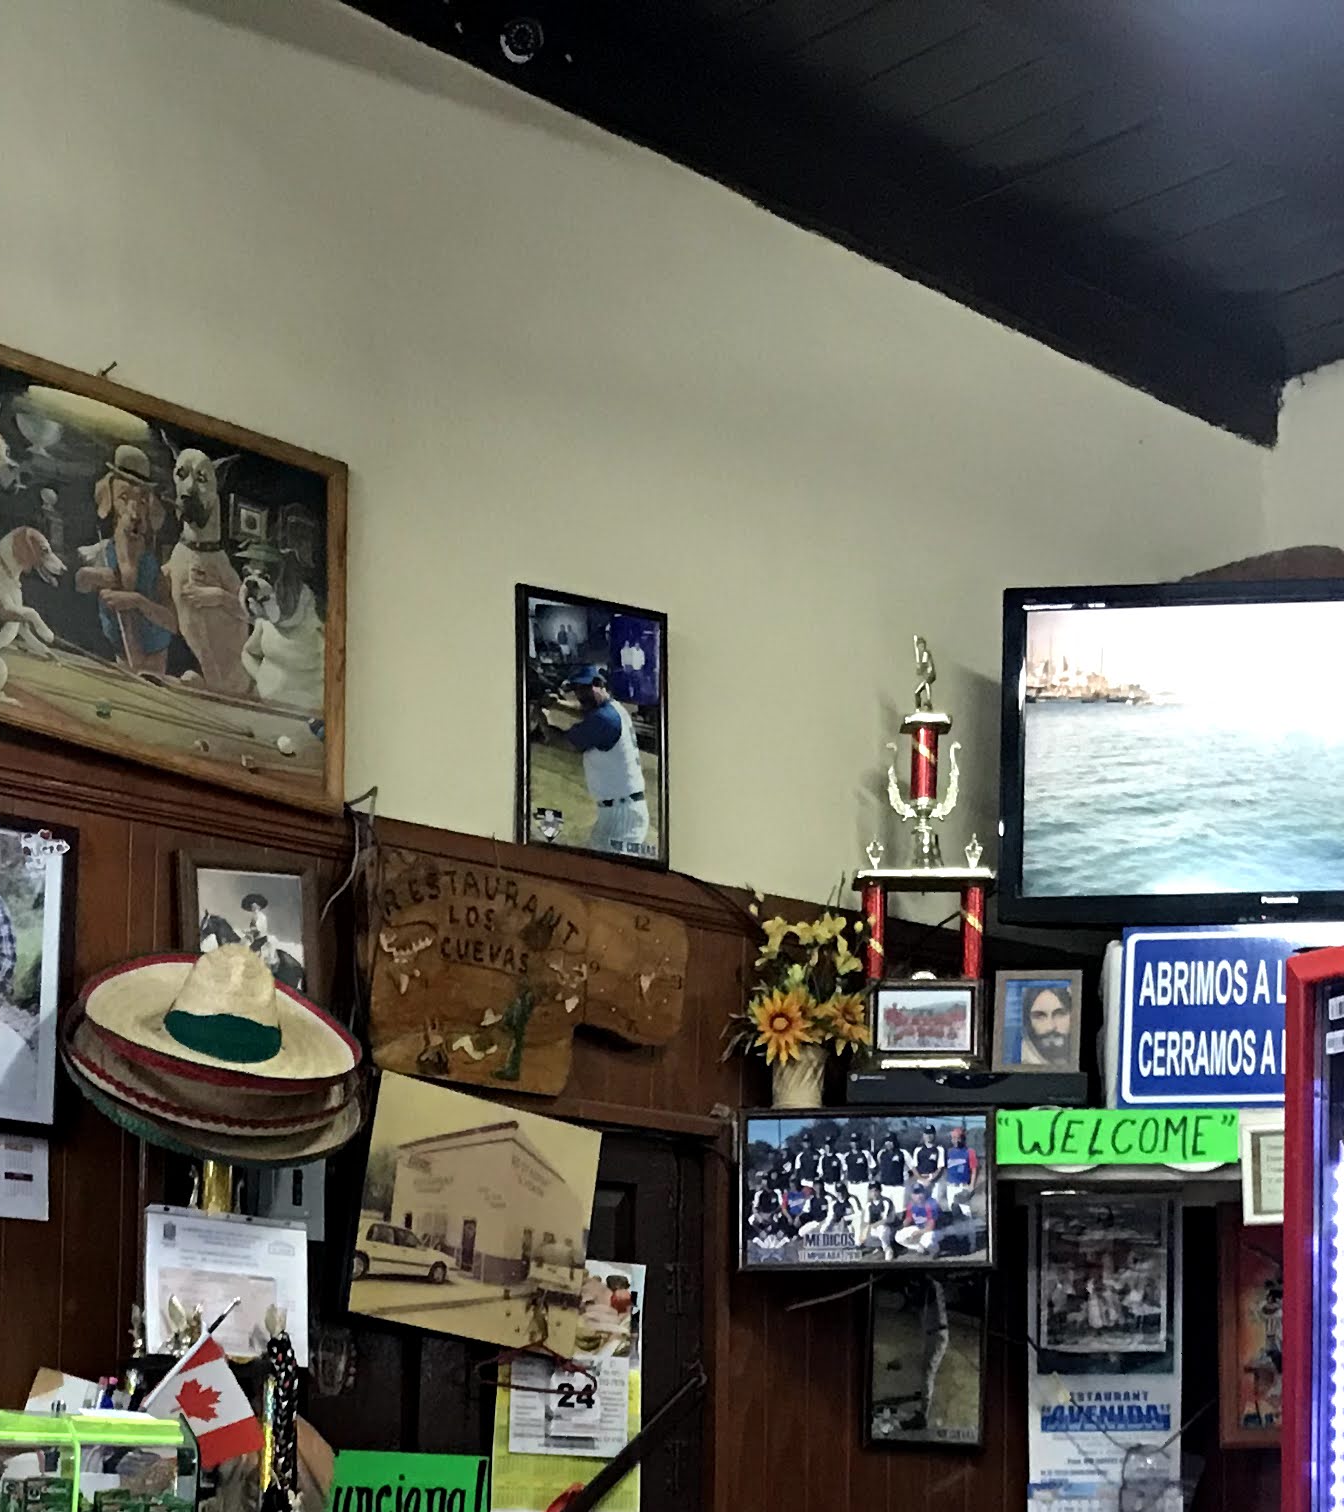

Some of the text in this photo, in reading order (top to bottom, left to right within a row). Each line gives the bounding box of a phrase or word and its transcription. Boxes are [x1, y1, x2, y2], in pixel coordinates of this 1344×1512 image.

[382, 869, 581, 946] RESTAURANT
[448, 904, 496, 932] LOS
[439, 936, 529, 974] CUEVAS
[1138, 959, 1249, 1006] ABRIMOS
[1252, 959, 1271, 1005] A
[1138, 1029, 1257, 1077] CERRAMOS
[1260, 1029, 1276, 1075] A
[557, 1382, 596, 1410] 24
[1070, 1391, 1149, 1402] STAURANT
